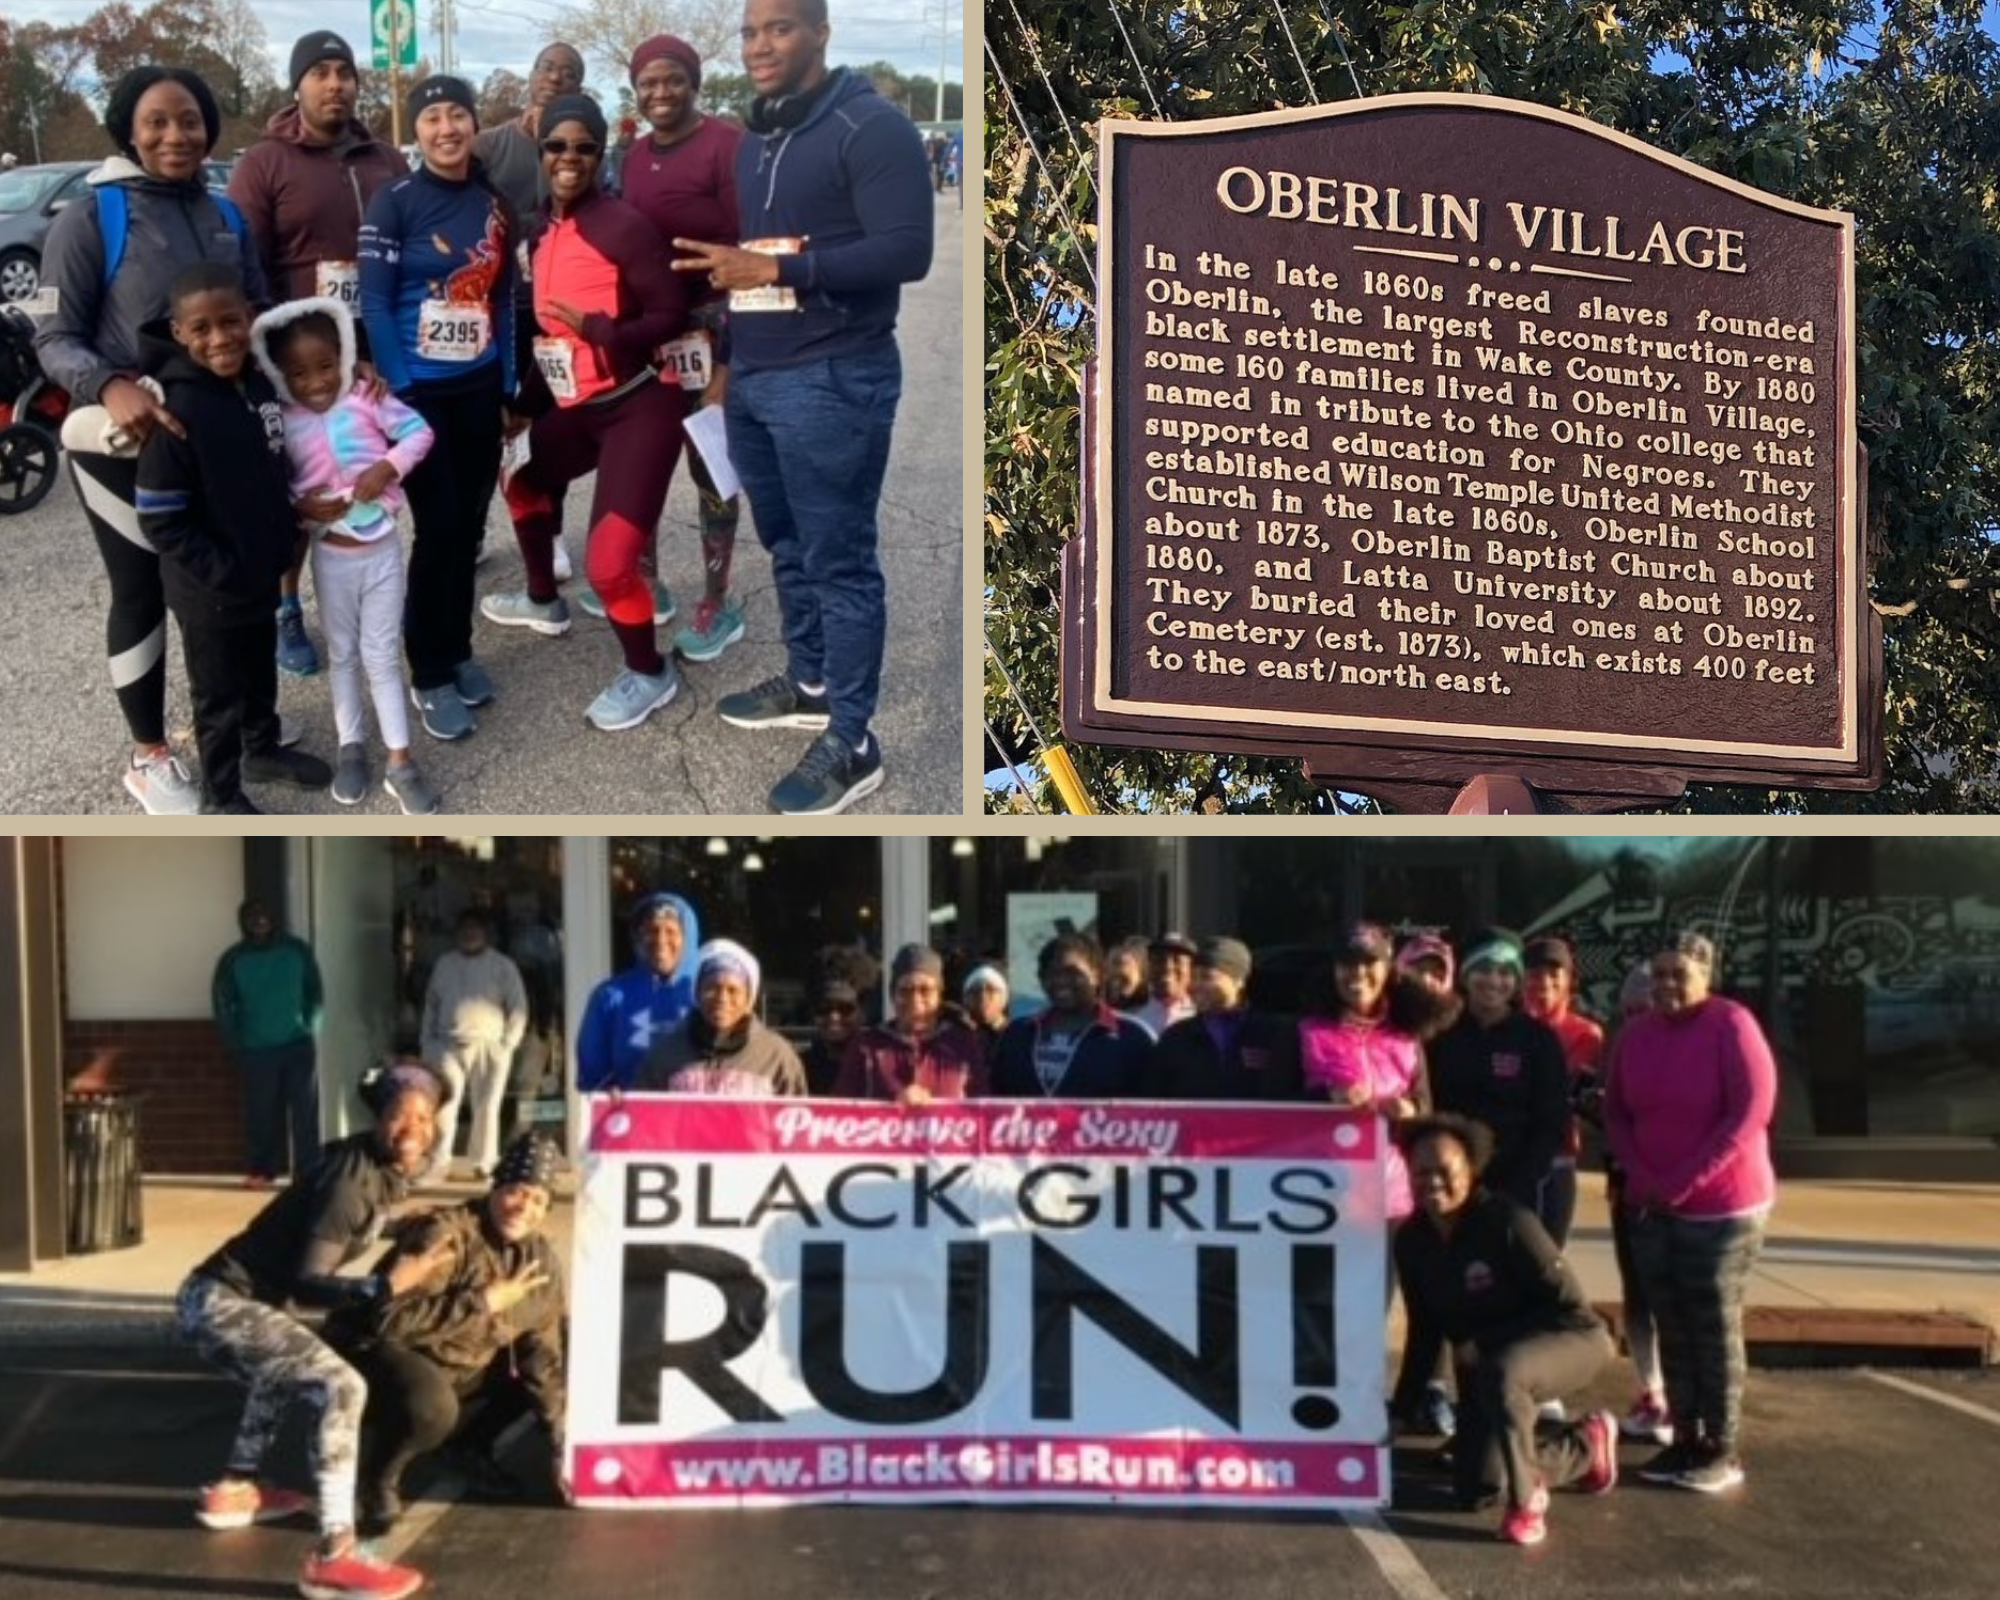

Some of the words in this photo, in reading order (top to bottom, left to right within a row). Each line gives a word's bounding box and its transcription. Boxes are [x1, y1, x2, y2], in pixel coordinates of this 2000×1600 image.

[1217, 166, 1479, 242] OBERLIN
[1506, 202, 1748, 273] VILLAGE
[429, 320, 480, 343] 2395
[1145, 244, 1176, 271] In
[1196, 251, 1250, 279] the
[1276, 260, 1338, 289] late
[1363, 270, 1443, 301] 1860s
[1467, 283, 1551, 313] freed
[1579, 296, 1668, 327] slaves
[1696, 309, 1814, 343] founded
[1145, 278, 1281, 318] Oberlin,
[1310, 298, 1362, 324] the
[1383, 305, 1492, 340] largest
[1519, 320, 1814, 374] Reconstruction-era
[1145, 311, 1230, 343] black
[1245, 326, 1415, 362] settlement
[1432, 342, 1462, 367] in
[1475, 346, 1552, 376] Wake
[1566, 357, 1681, 392] County.
[1704, 371, 1742, 399] By
[1757, 377, 1815, 404] 1880
[1145, 351, 1224, 374] some
[1236, 354, 1284, 380] 160
[1296, 361, 1424, 396] families
[1437, 375, 1514, 405] lived
[1528, 385, 1558, 410] in
[1572, 390, 1687, 424] Oberlin
[1705, 404, 1815, 440] Village,
[1145, 418, 1309, 450] supported
[1332, 432, 1485, 467] education
[1509, 448, 1555, 473] for
[1582, 453, 1715, 488] Negroes.
[1739, 469, 1815, 501] They
[1146, 383, 1251, 411] named
[1270, 391, 1301, 416] in
[1316, 396, 1431, 429] tribute
[1441, 408, 1475, 433] to
[1487, 414, 1539, 440] the
[1551, 420, 1623, 448] Ohio
[1637, 431, 1742, 465] college
[1752, 440, 1815, 467] that
[1145, 448, 1331, 485] established
[1339, 462, 1441, 495] Wilson
[1447, 472, 1554, 508] Temple
[1561, 483, 1660, 515] United
[1671, 494, 1815, 528] Methodist
[1146, 476, 1257, 510] Church
[1272, 488, 1303, 514] in
[1321, 493, 1372, 519] the
[1393, 499, 1454, 527] late
[1472, 507, 1558, 540] 1860s,
[1585, 517, 1698, 549] Oberlin
[1717, 530, 1814, 559] School
[1145, 512, 1240, 541] about
[1257, 520, 1330, 553] 1873,
[1351, 529, 1471, 562] Oberlin
[1487, 540, 1596, 573] Baptist
[1611, 552, 1716, 583] Church
[1732, 563, 1814, 590] about
[1146, 544, 1223, 574] 1880,
[1254, 558, 1312, 581] and
[1342, 560, 1429, 591] Latta
[1453, 570, 1616, 609] University
[1639, 587, 1721, 615] about
[1744, 595, 1814, 622] 1892.
[1146, 577, 1232, 612] They
[1250, 585, 1355, 618] buried
[1377, 597, 1456, 626] their
[1475, 604, 1554, 634] loved
[1572, 619, 1636, 640] ones
[1654, 621, 1683, 643] at
[1703, 623, 1815, 654] Oberlin
[1146, 611, 1305, 650] Cemetery
[1315, 626, 1383, 653] (est.
[1398, 631, 1481, 662] 1873),
[1501, 641, 1585, 668] which
[1595, 650, 1681, 675] exists
[1693, 655, 1745, 679] 400
[1755, 659, 1815, 685] feet
[1146, 645, 1183, 671] to
[1192, 649, 1246, 675] the
[1258, 657, 1427, 688] east/north
[1435, 671, 1511, 695] east.
[775, 1106, 976, 1147] Preserve
[990, 1106, 1058, 1148] the
[1073, 1108, 1179, 1155] Sexy
[624, 1162, 976, 1229] BLACK
[1017, 1163, 1338, 1235] GIRLS
[616, 1232, 1341, 1434] RUN!
[671, 1445, 1294, 1488] www.BlackGirlsRun.com
